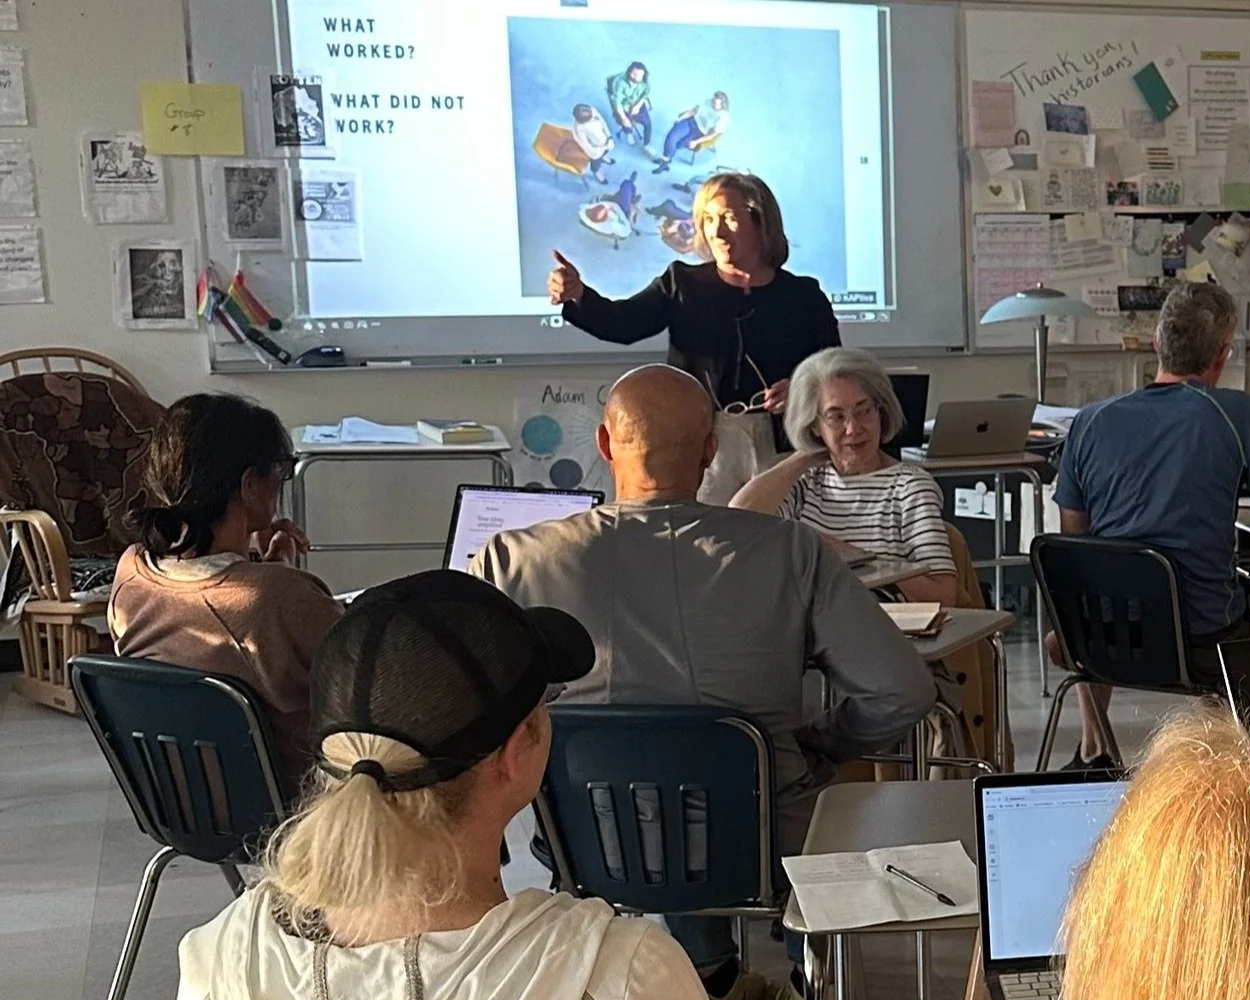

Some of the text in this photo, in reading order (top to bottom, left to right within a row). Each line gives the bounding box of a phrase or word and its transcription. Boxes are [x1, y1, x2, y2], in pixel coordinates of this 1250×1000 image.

[323, 17, 375, 33] WHAT
[326, 43, 415, 59] WORKED?
[1000, 52, 1082, 97] Thank
[330, 93, 465, 110] WHAT DID NOT
[335, 118, 394, 134] WORK?
[542, 384, 586, 405] Adam
